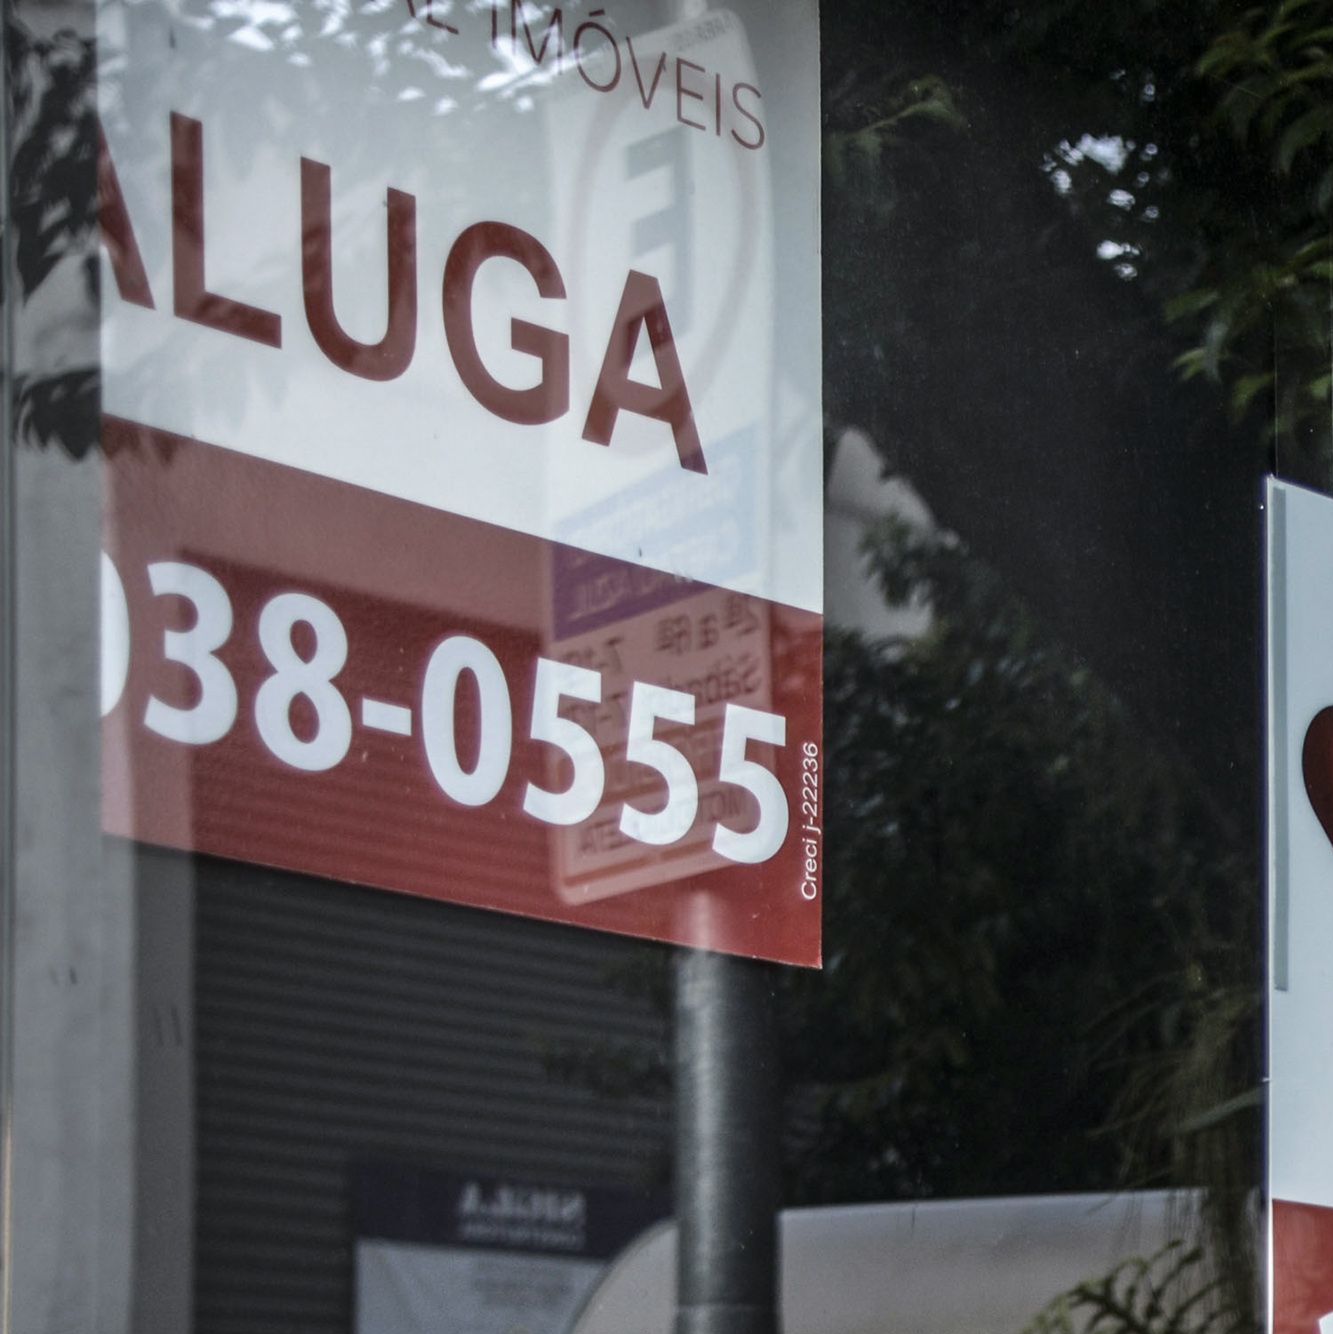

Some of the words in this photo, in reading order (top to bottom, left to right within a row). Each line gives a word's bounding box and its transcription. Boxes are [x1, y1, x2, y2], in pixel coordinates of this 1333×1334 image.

[489, 0, 767, 151] IMÓVEIS
[802, 742, 822, 834] j-22236
[801, 838, 819, 900] Creci
